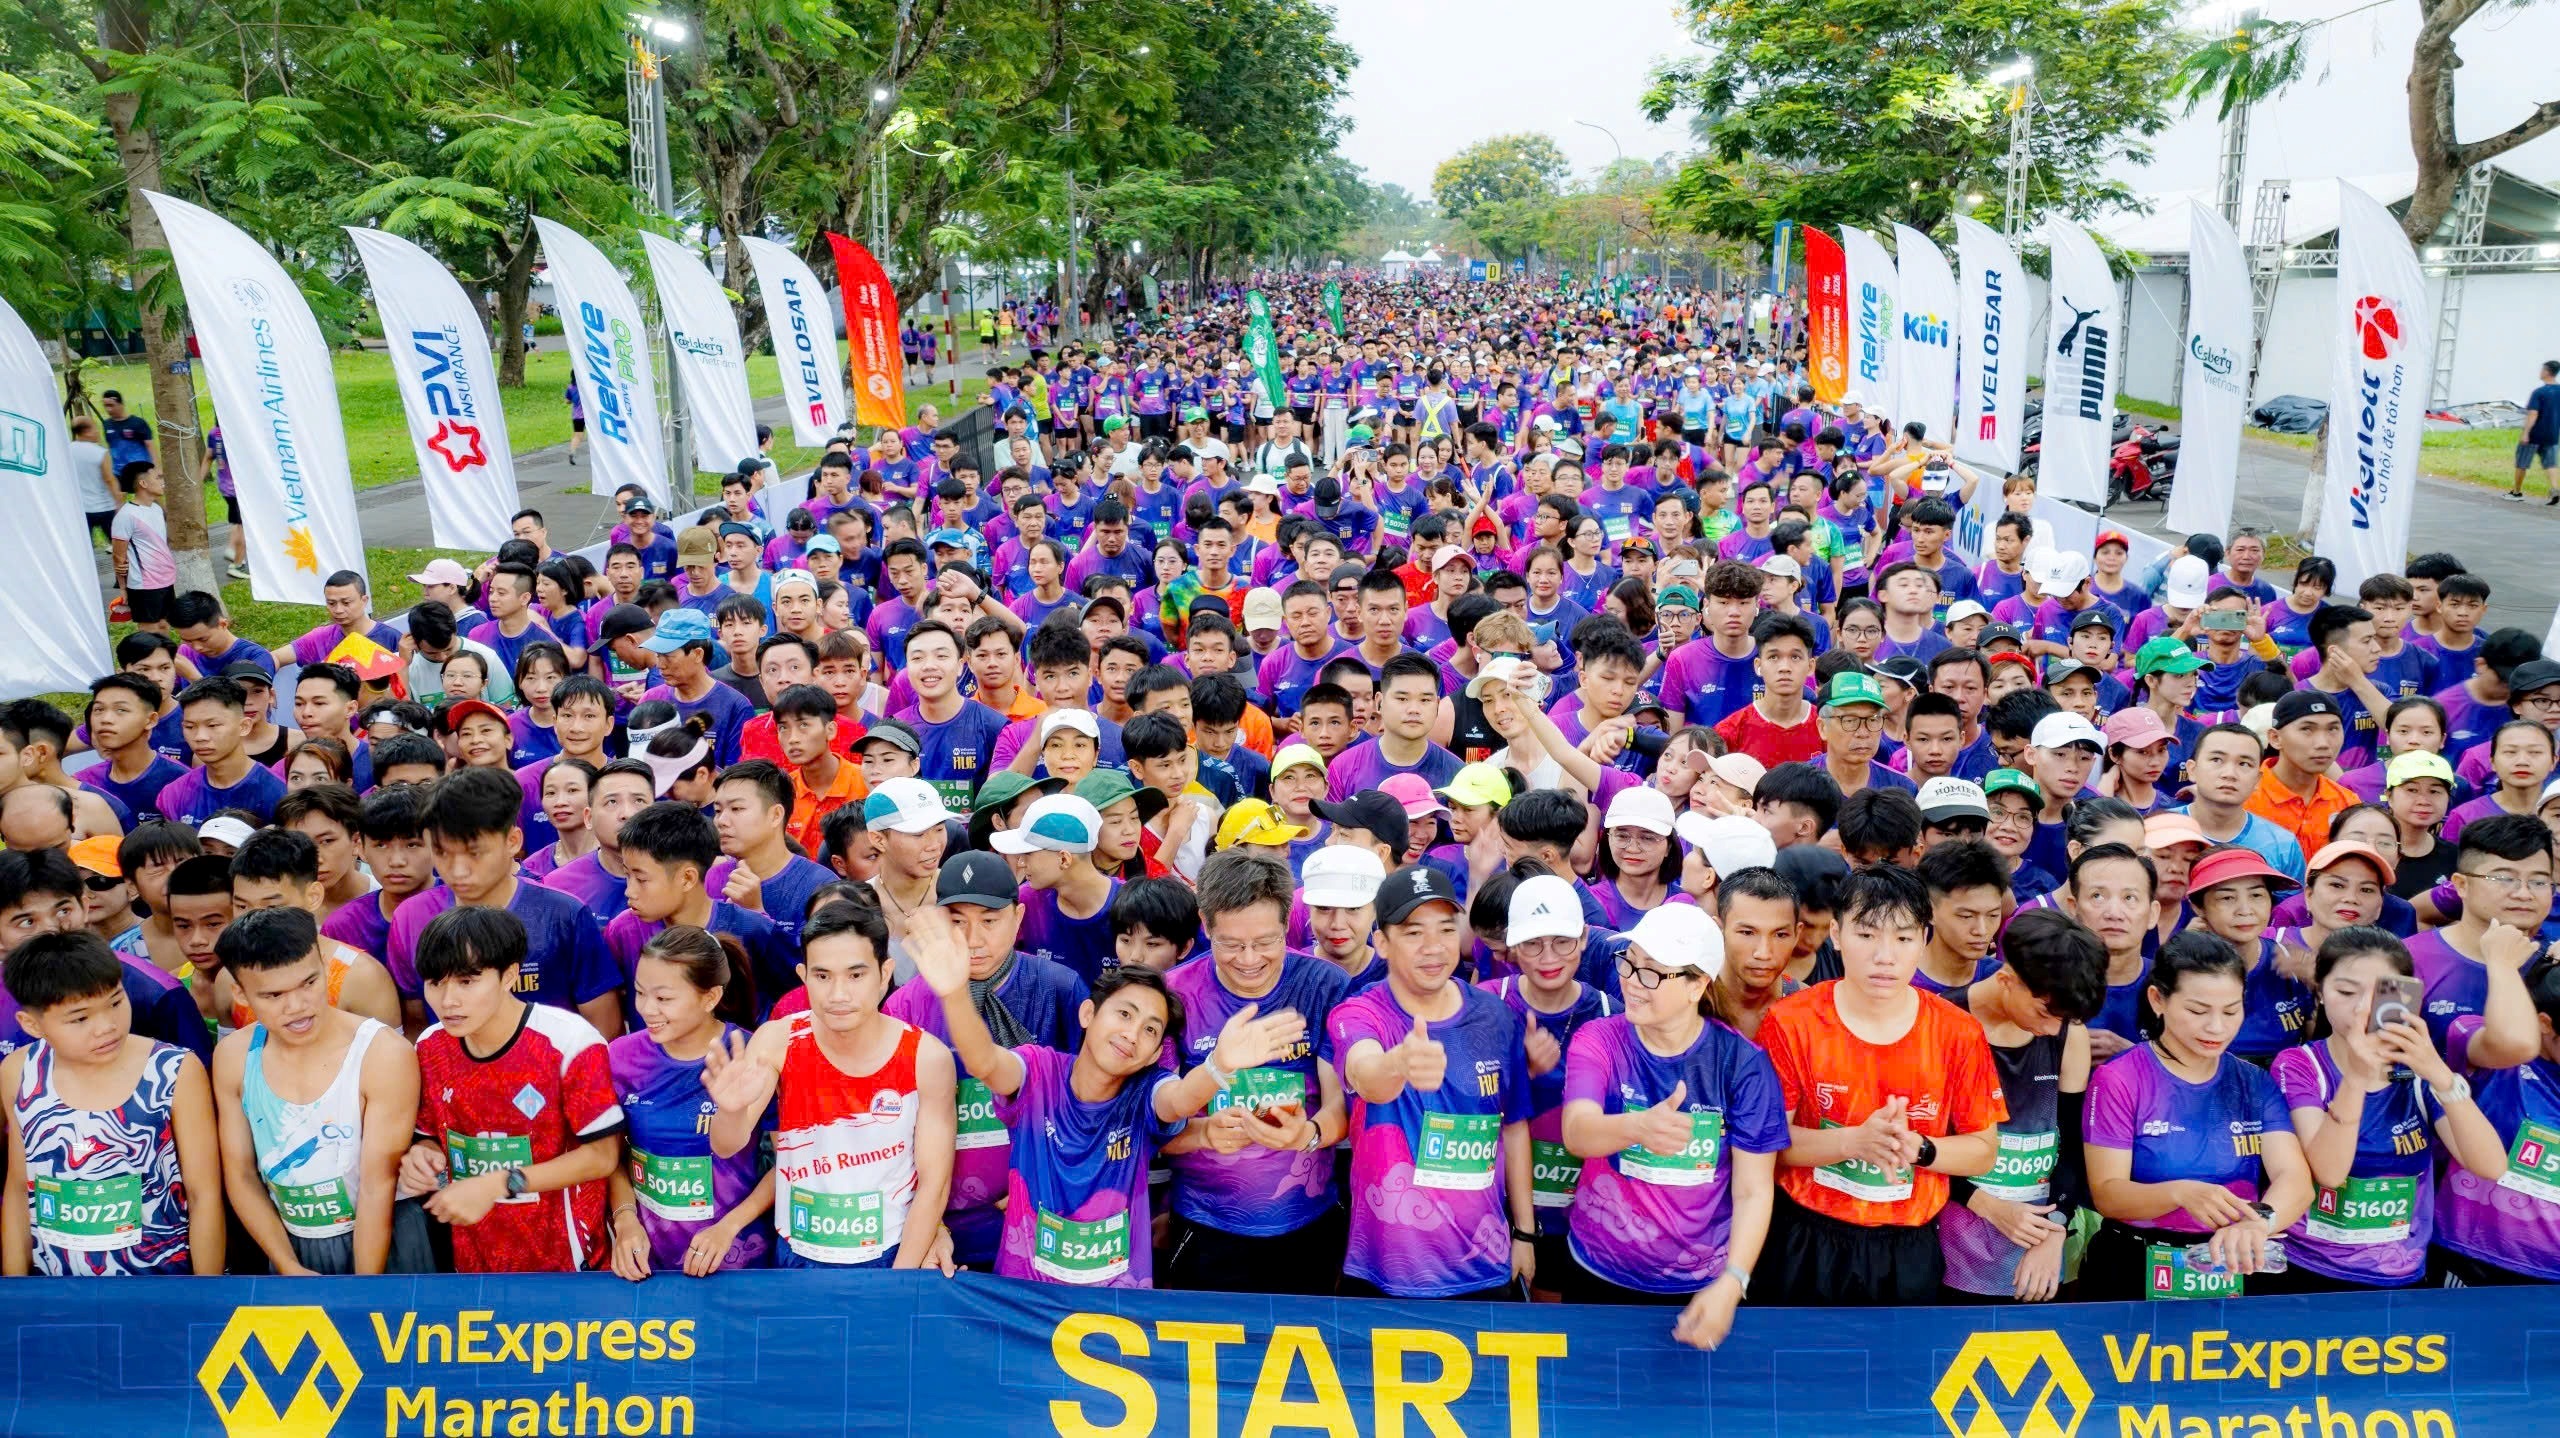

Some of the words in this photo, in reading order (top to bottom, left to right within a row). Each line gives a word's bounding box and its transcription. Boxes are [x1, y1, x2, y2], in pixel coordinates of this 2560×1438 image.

[1489, 265, 1497, 279] D
[1880, 293, 1894, 340] PRO
[674, 331, 723, 357] Carlsberg
[782, 278, 822, 402] VELOSAR
[1982, 269, 2003, 416] VELOSAR
[611, 318, 639, 385] PRO
[411, 330, 461, 417] PVI
[442, 323, 477, 419] INSURANCE
[2079, 325, 2109, 422] PUMA
[2203, 373, 2241, 396] Vietnam
[953, 756, 977, 771] HUE
[1935, 785, 1978, 797] HOMIES
[510, 973, 540, 993] UE
[2427, 1000, 2456, 1015] FPT
[2142, 1120, 2170, 1136] FPT
[836, 1140, 906, 1171] Runners
[1429, 1136, 1441, 1156] C
[2522, 1145, 2539, 1164] A
[453, 1153, 464, 1170] A
[1994, 1154, 2053, 1175] 50690
[647, 1172, 705, 1196] 50146
[1534, 1164, 1582, 1183] 0477
[42, 1197, 53, 1215] A
[59, 1200, 133, 1224] 50727
[283, 1200, 342, 1218] 51715
[2320, 1193, 2334, 1212] A
[2342, 1200, 2409, 1219] 51602
[796, 1209, 806, 1228] A
[810, 1215, 878, 1236] 50468
[1043, 1232, 1053, 1250] D
[1060, 1236, 1123, 1261] 52441
[2156, 1269, 2169, 1288] A
[369, 1309, 697, 1375] VnExpress
[2102, 1329, 2447, 1390] VnExpress
[1048, 1312, 1569, 1438] START
[386, 1381, 695, 1438] Marathon
[2117, 1396, 2457, 1438] Marathon
